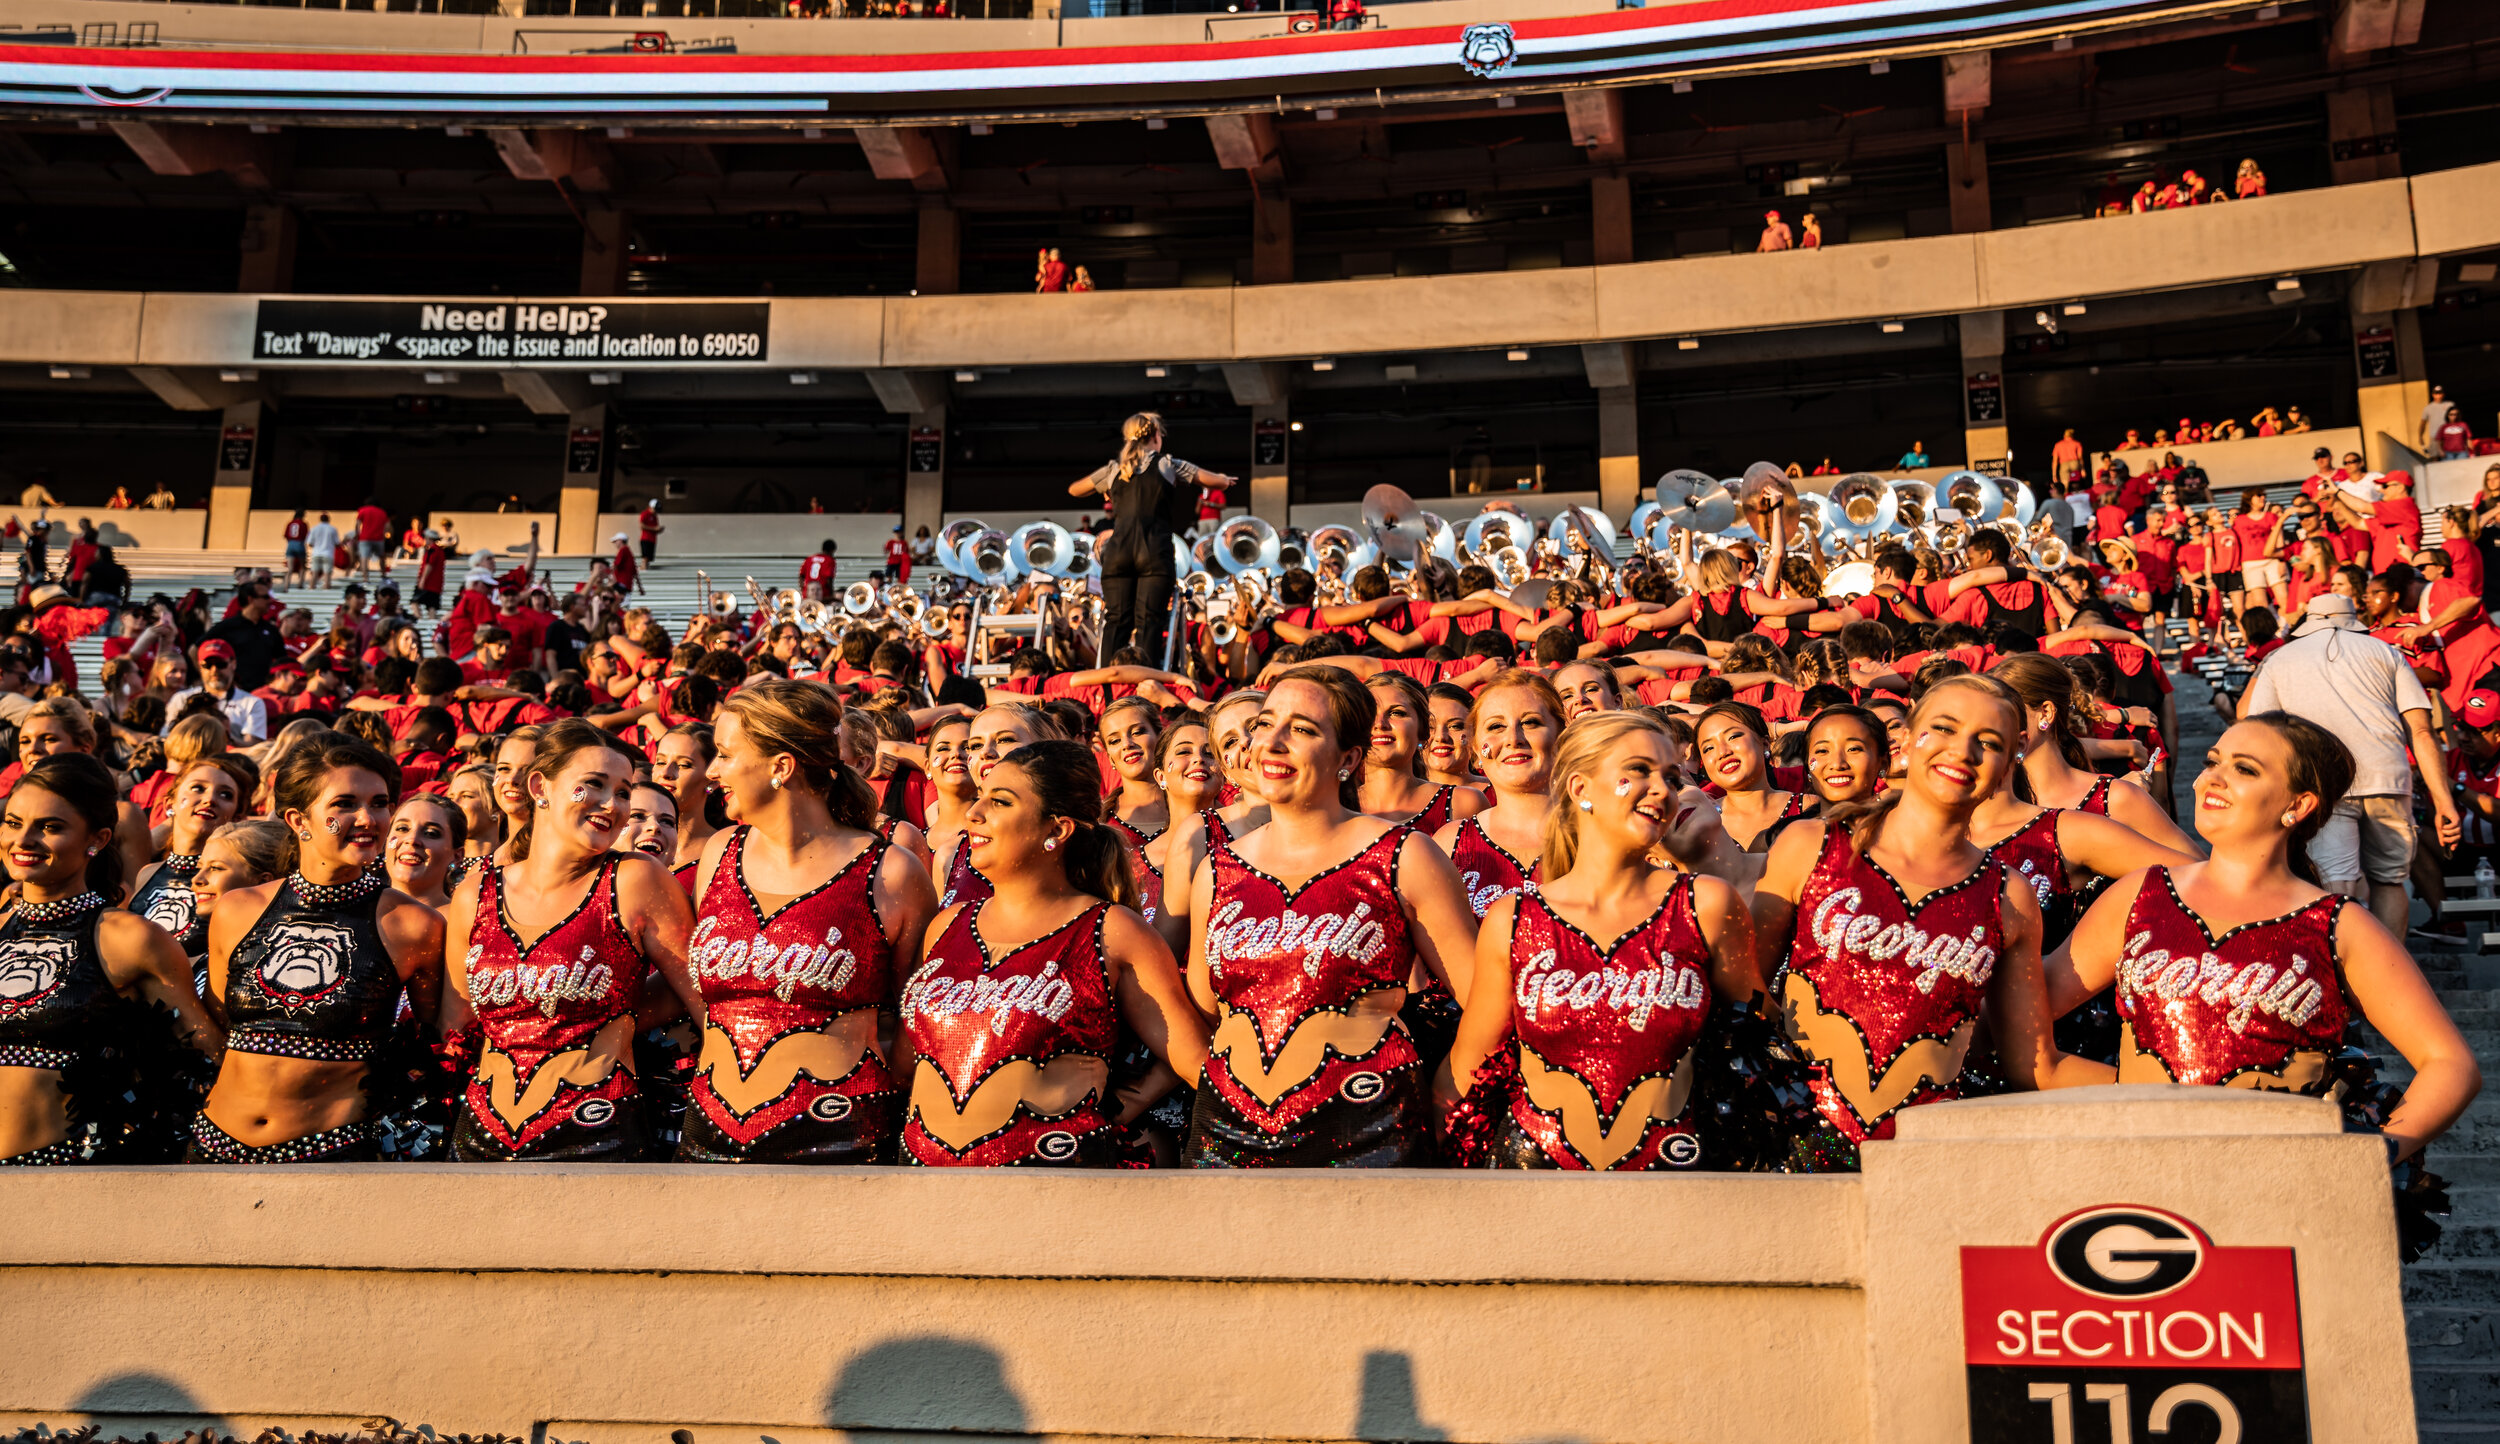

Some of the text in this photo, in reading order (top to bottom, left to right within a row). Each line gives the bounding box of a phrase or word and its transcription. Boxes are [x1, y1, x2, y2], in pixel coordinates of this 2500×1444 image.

[420, 305, 608, 335] Need Help?
[262, 331, 760, 359] Text "Dawgs" <space> the issue and location to 69050
[1975, 460, 2005, 471] DO NOT
[688, 915, 857, 1003] Georgia
[1204, 900, 1387, 979] Georgia
[1811, 887, 1996, 995] Georgia
[900, 957, 1074, 1038] Georgia
[1515, 948, 1704, 1032] Georgia
[2115, 930, 2324, 1035] Georgia
[809, 1093, 853, 1122] G
[1341, 1071, 1385, 1103] G
[572, 1097, 616, 1126] G
[1035, 1131, 1078, 1160] G
[1658, 1133, 1699, 1164] G
[2048, 1209, 2202, 1300] G
[1996, 1309, 2265, 1359] SECTION
